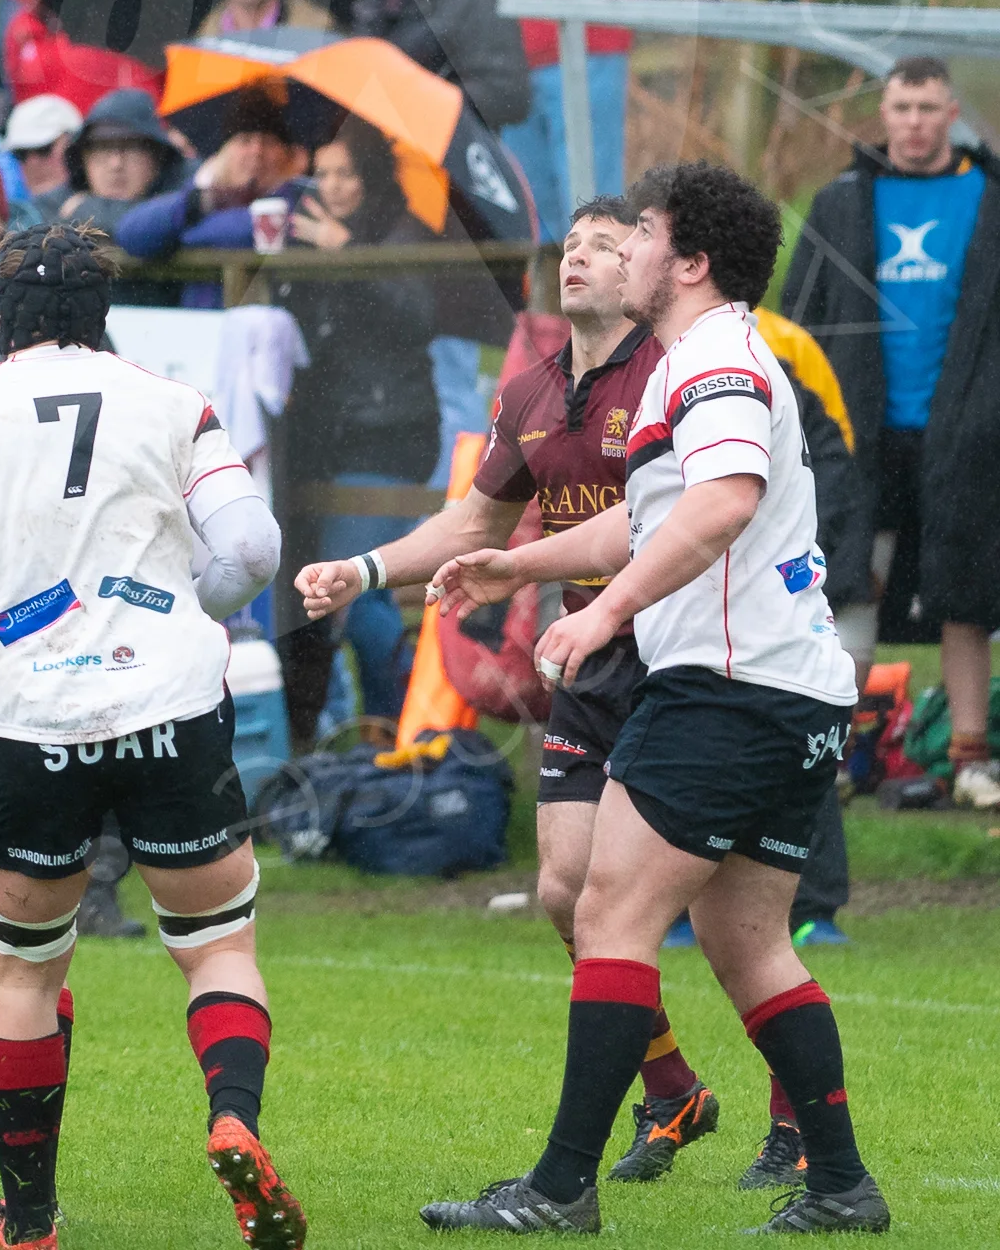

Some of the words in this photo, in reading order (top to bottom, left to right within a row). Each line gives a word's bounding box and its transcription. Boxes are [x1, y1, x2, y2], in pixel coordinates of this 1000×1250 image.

[34, 392, 103, 499] 7
[602, 447, 627, 458] RUGBY
[540, 483, 623, 514] RANG
[13, 585, 66, 620] JOHNSON
[132, 829, 229, 855] SOARONLINE.CO.UK
